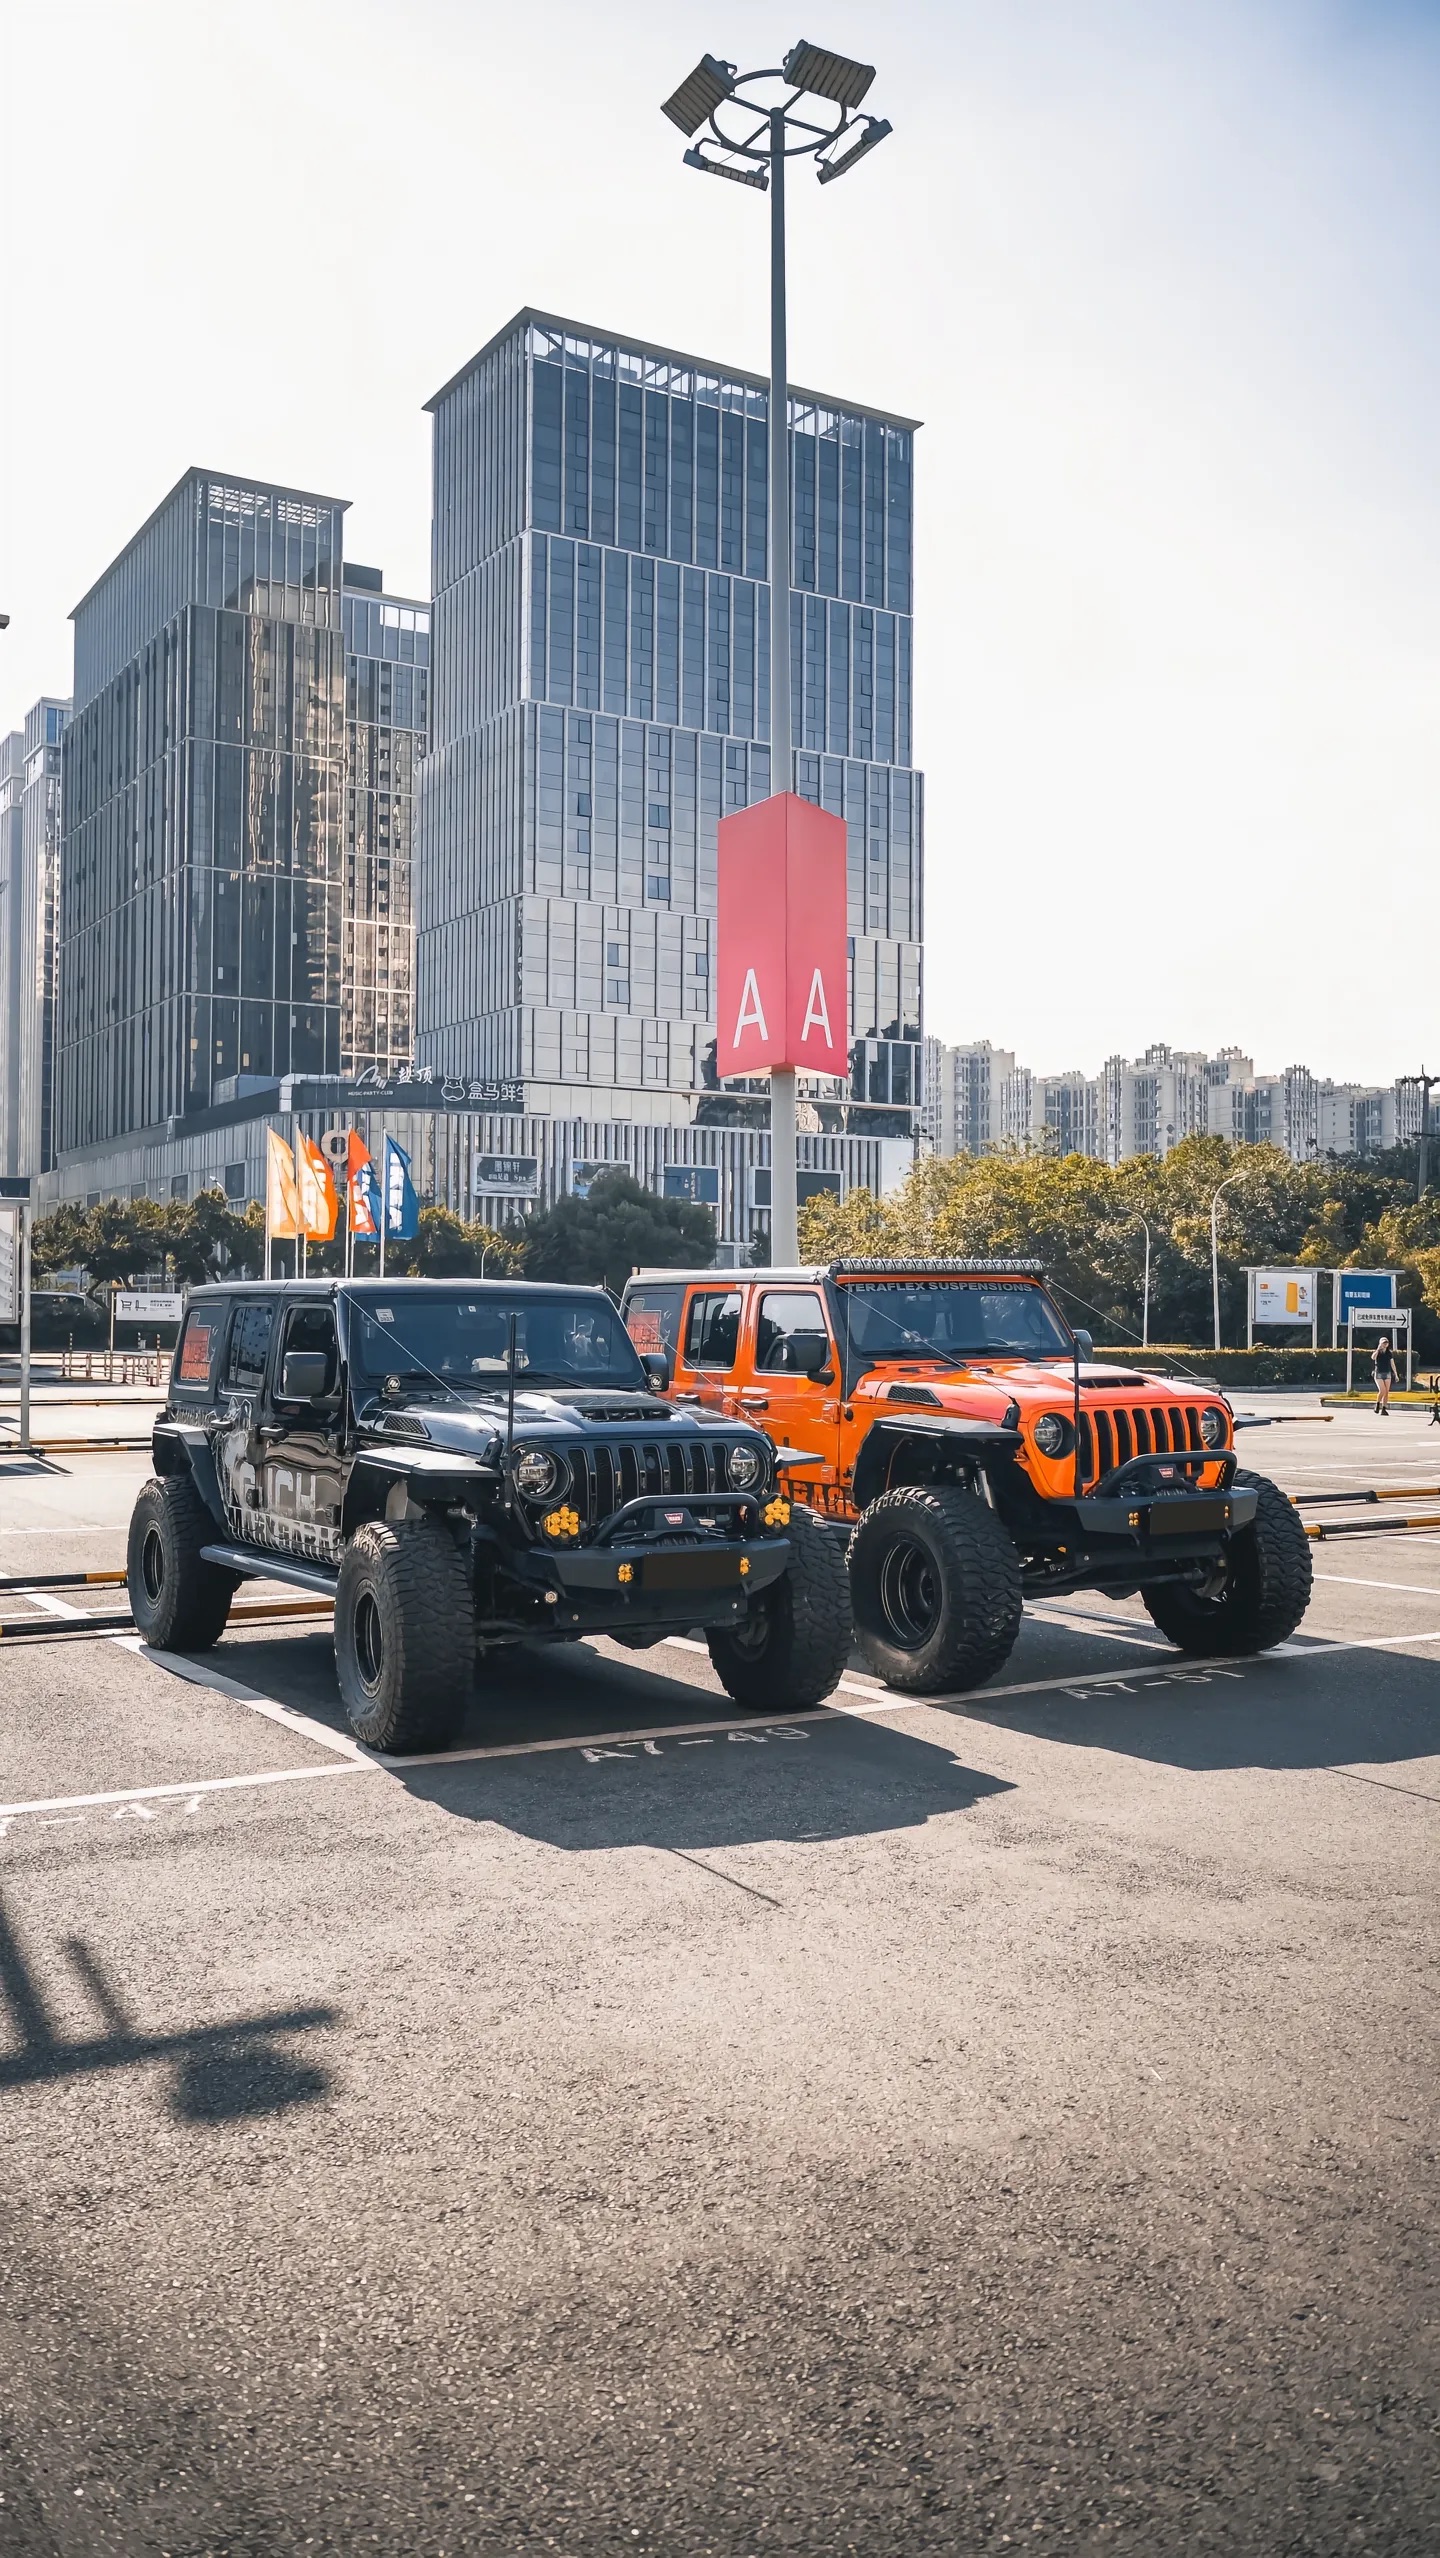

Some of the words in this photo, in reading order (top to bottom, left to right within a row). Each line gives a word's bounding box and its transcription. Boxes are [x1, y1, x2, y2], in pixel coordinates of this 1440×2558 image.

[732, 967, 769, 1049] A
[800, 967, 834, 1049] A
[389, 1152, 404, 1230] IKEA
[845, 1283, 925, 1292] TERAFLEX
[928, 1282, 1033, 1292] SUSPENSIONS
[579, 1727, 811, 1763] A7-49
